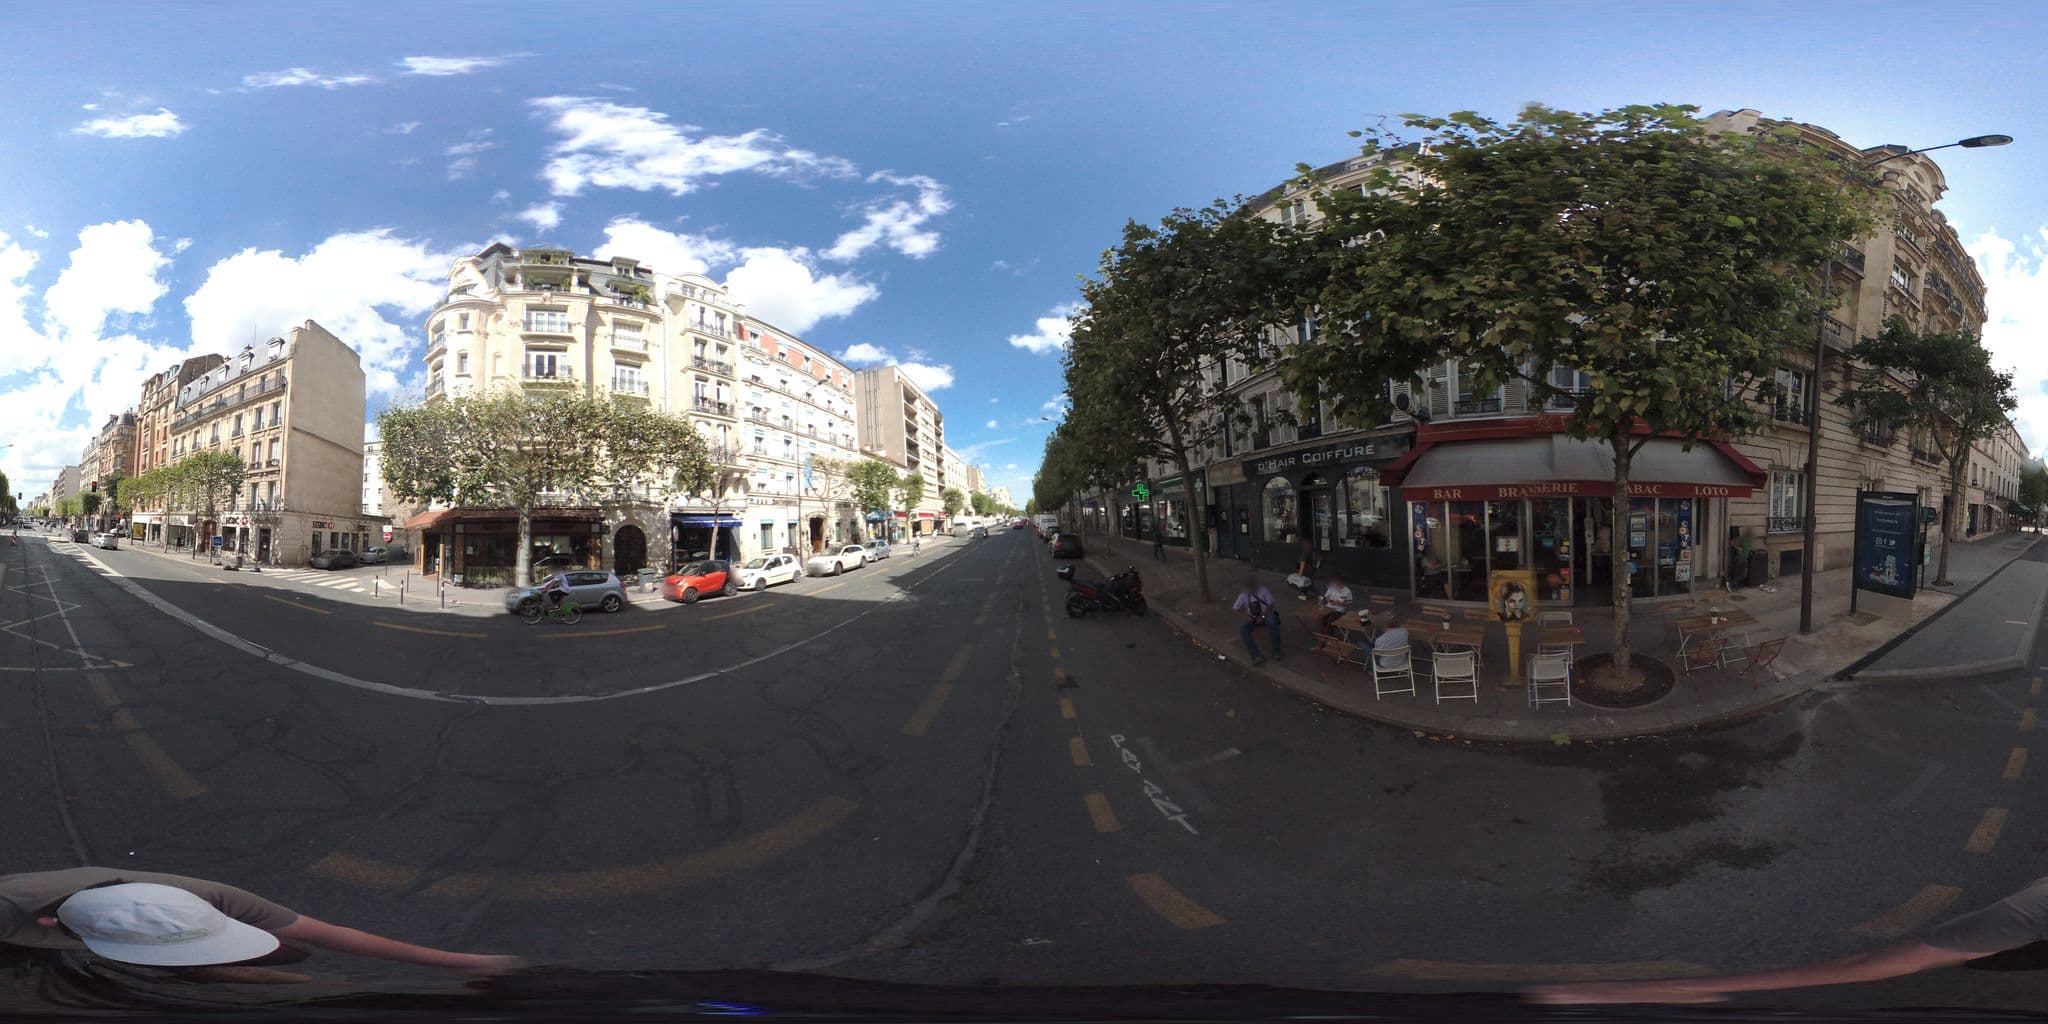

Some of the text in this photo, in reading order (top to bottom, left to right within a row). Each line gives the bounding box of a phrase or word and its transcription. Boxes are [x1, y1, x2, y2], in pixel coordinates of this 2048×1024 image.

[1302, 445, 1376, 464] COIFFURE
[1434, 488, 1462, 499] BAR
[1625, 484, 1664, 495] ABAC
[1695, 486, 1729, 496] LOTO
